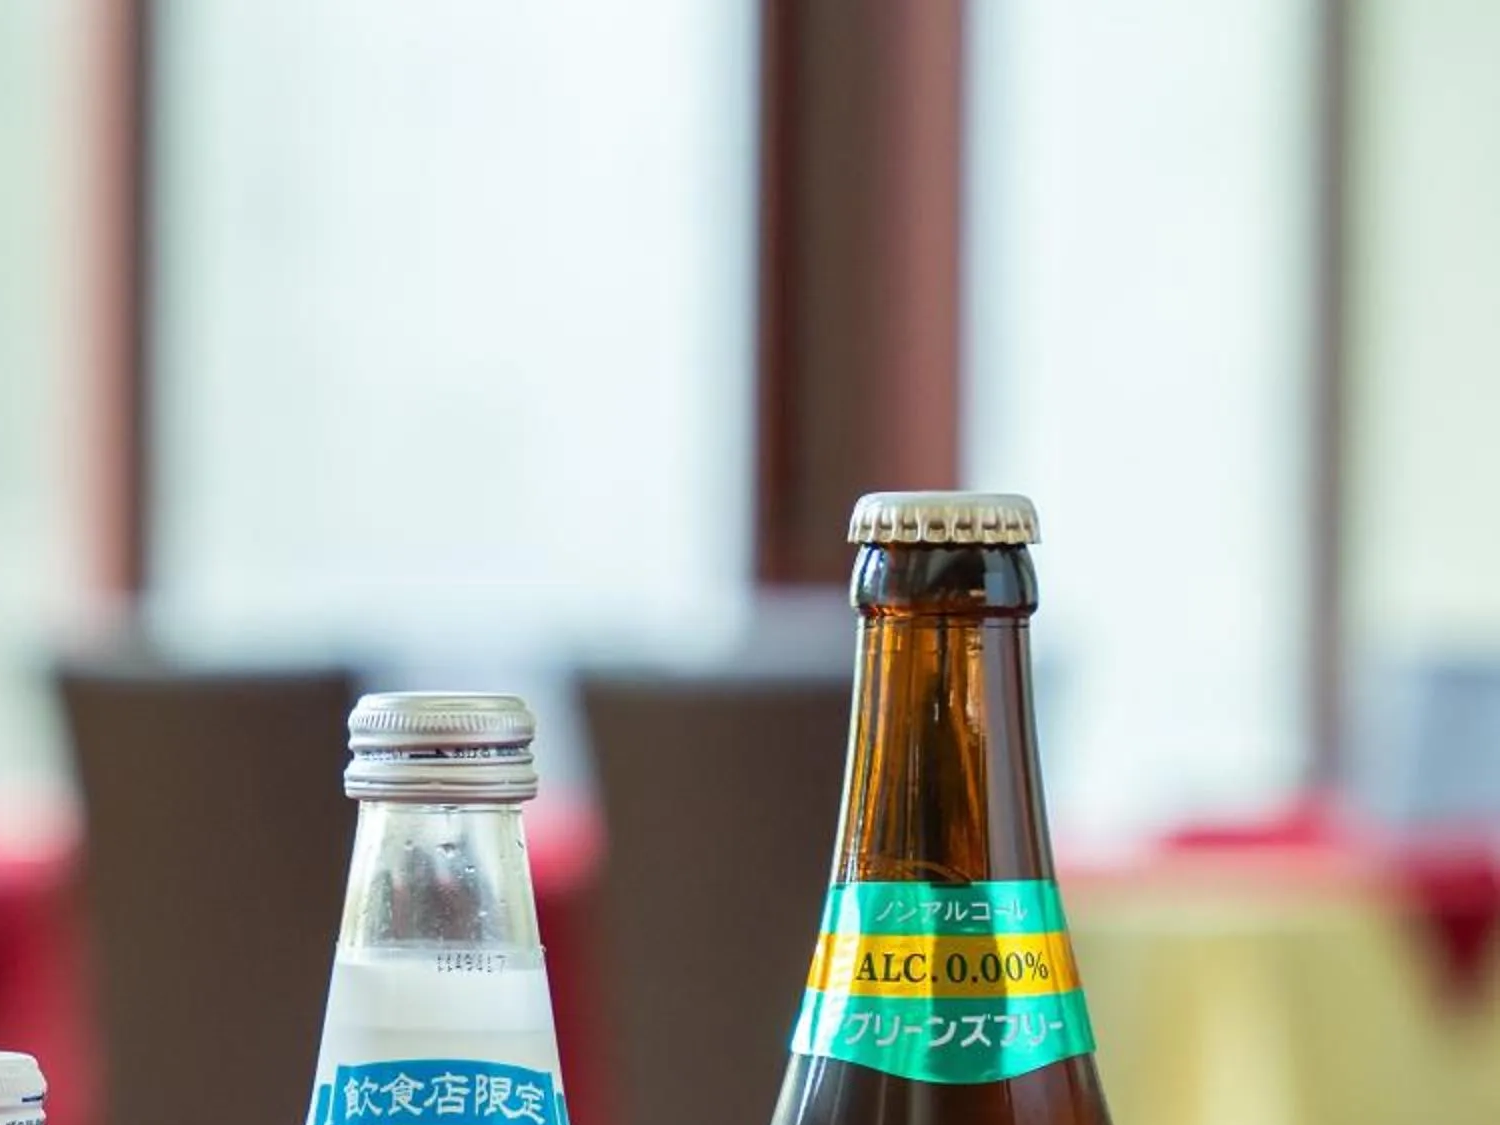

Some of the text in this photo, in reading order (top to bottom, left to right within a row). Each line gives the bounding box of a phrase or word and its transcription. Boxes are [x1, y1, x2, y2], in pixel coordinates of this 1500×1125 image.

[876, 900, 1028, 922] ノンアルコール
[856, 951, 1049, 983] ALC. 0.00%
[844, 1013, 1064, 1048] グリーンズフリー
[343, 1072, 546, 1125] 飲食店限定
